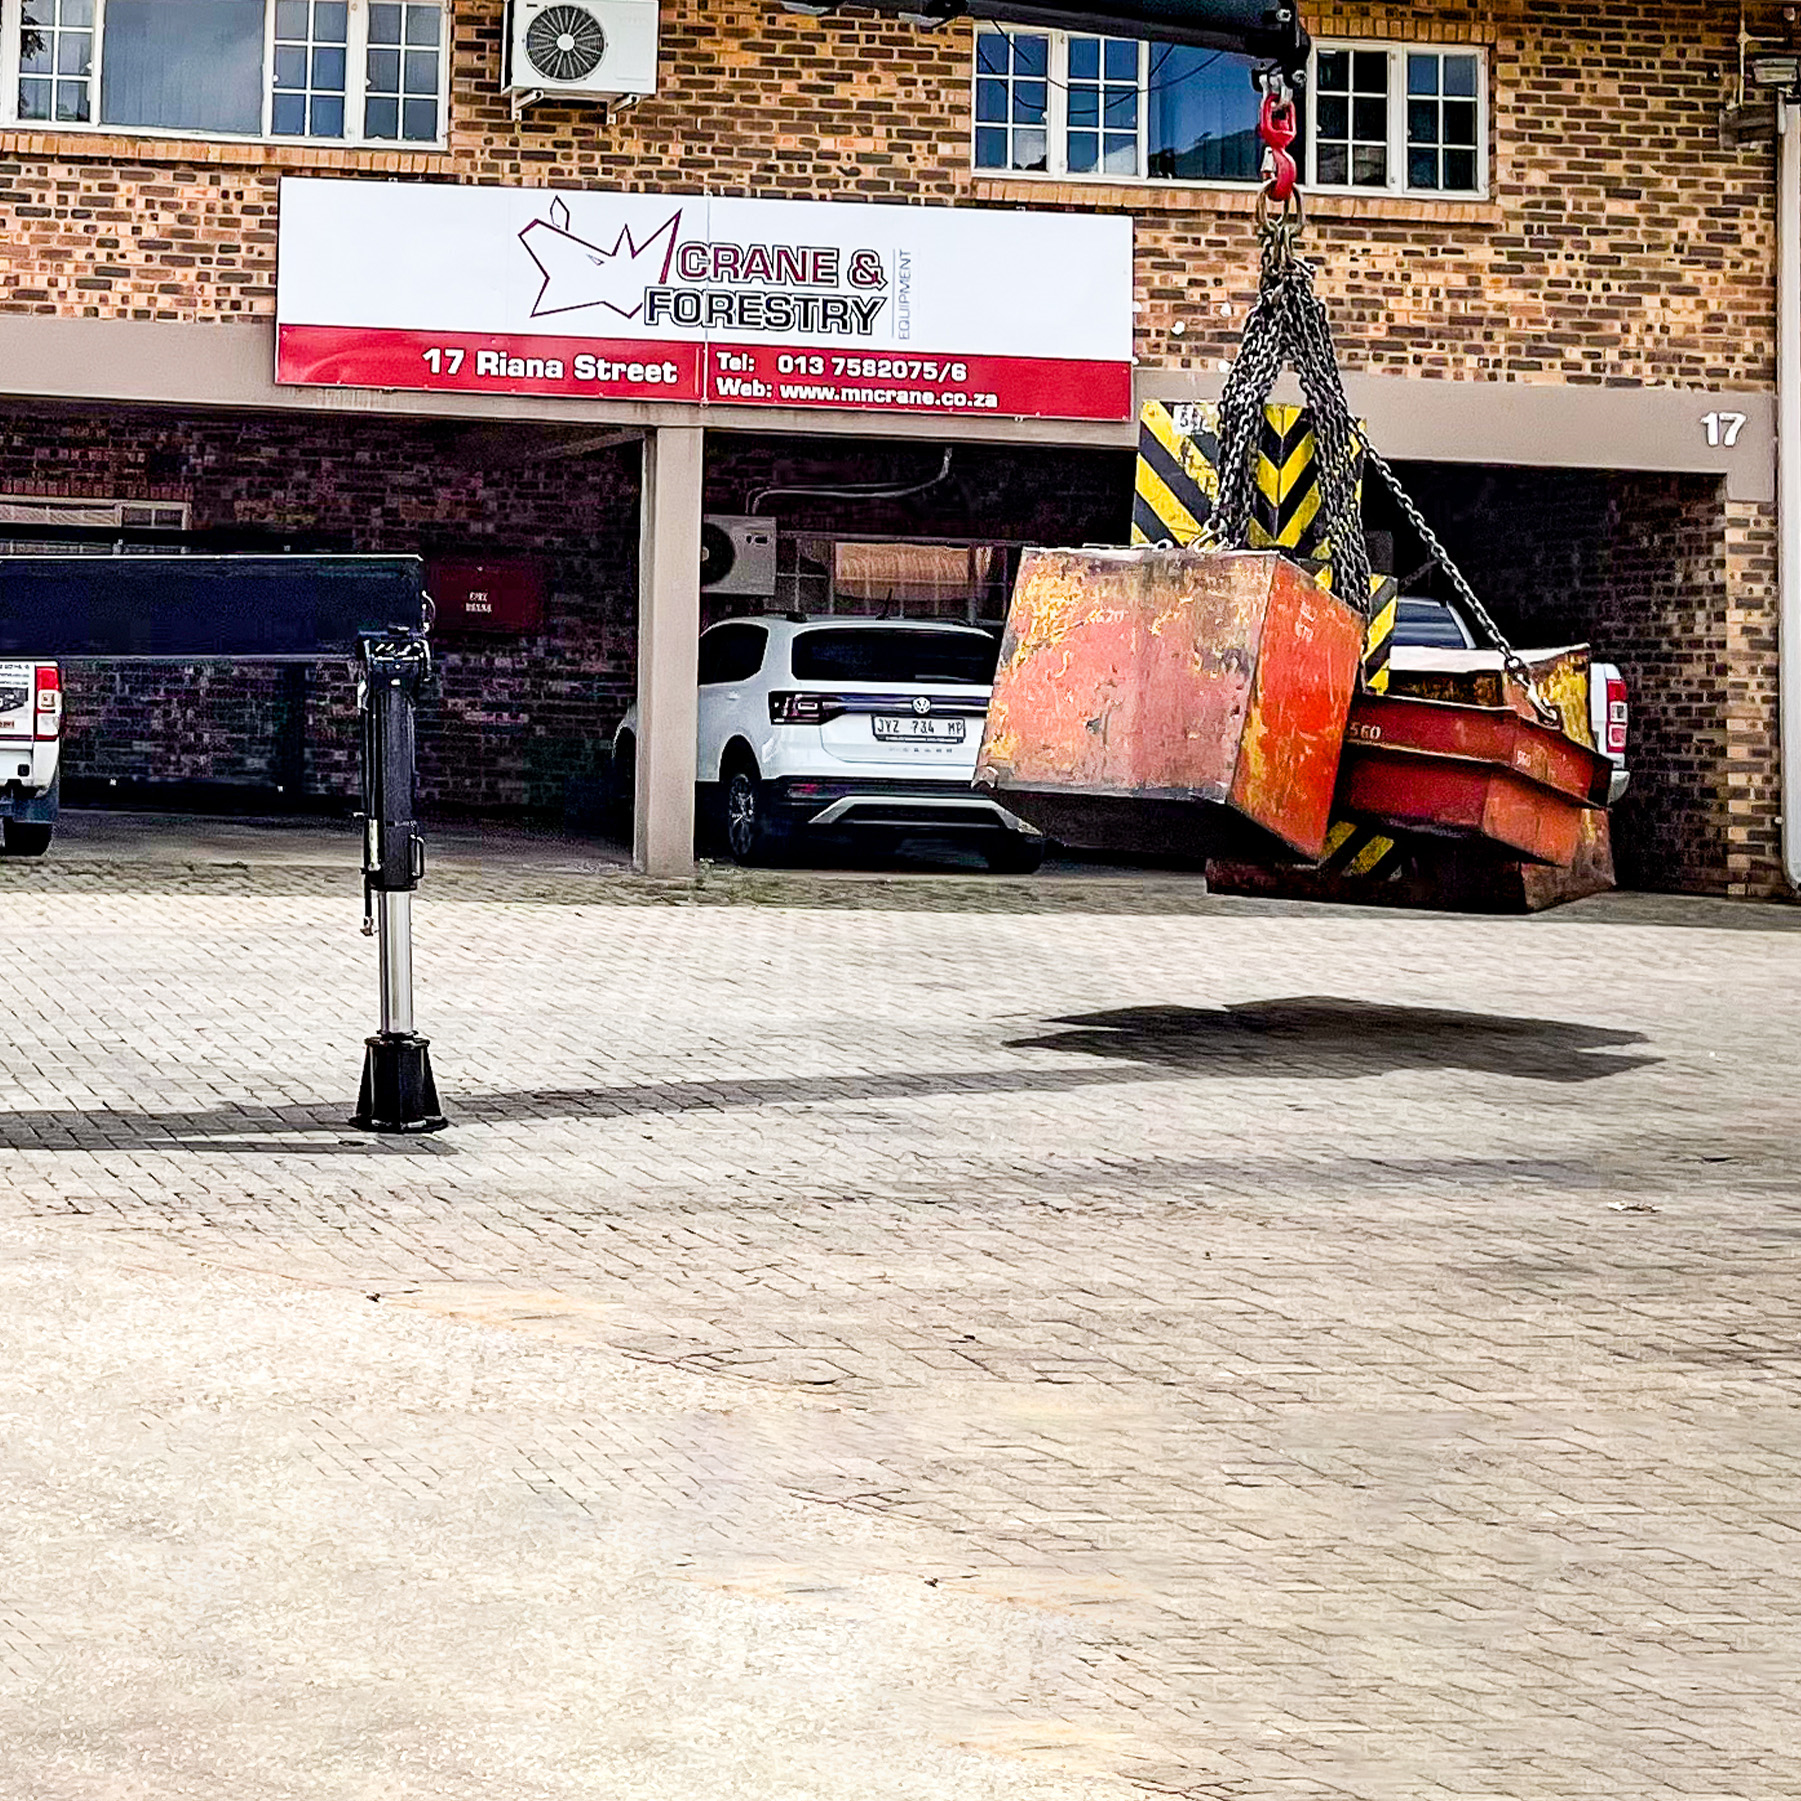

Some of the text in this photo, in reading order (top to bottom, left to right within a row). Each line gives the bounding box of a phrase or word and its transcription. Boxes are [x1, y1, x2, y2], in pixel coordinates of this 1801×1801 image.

[676, 241, 888, 291] CRANE &
[644, 287, 888, 335] FORESTRY
[898, 249, 912, 340] EQUIPMENT
[422, 348, 677, 384] 17 Riana Street
[716, 352, 968, 383] Tel: 013 7582075/6
[716, 377, 998, 408] Web: www.mncrane.co.za
[1700, 412, 1747, 447] 17
